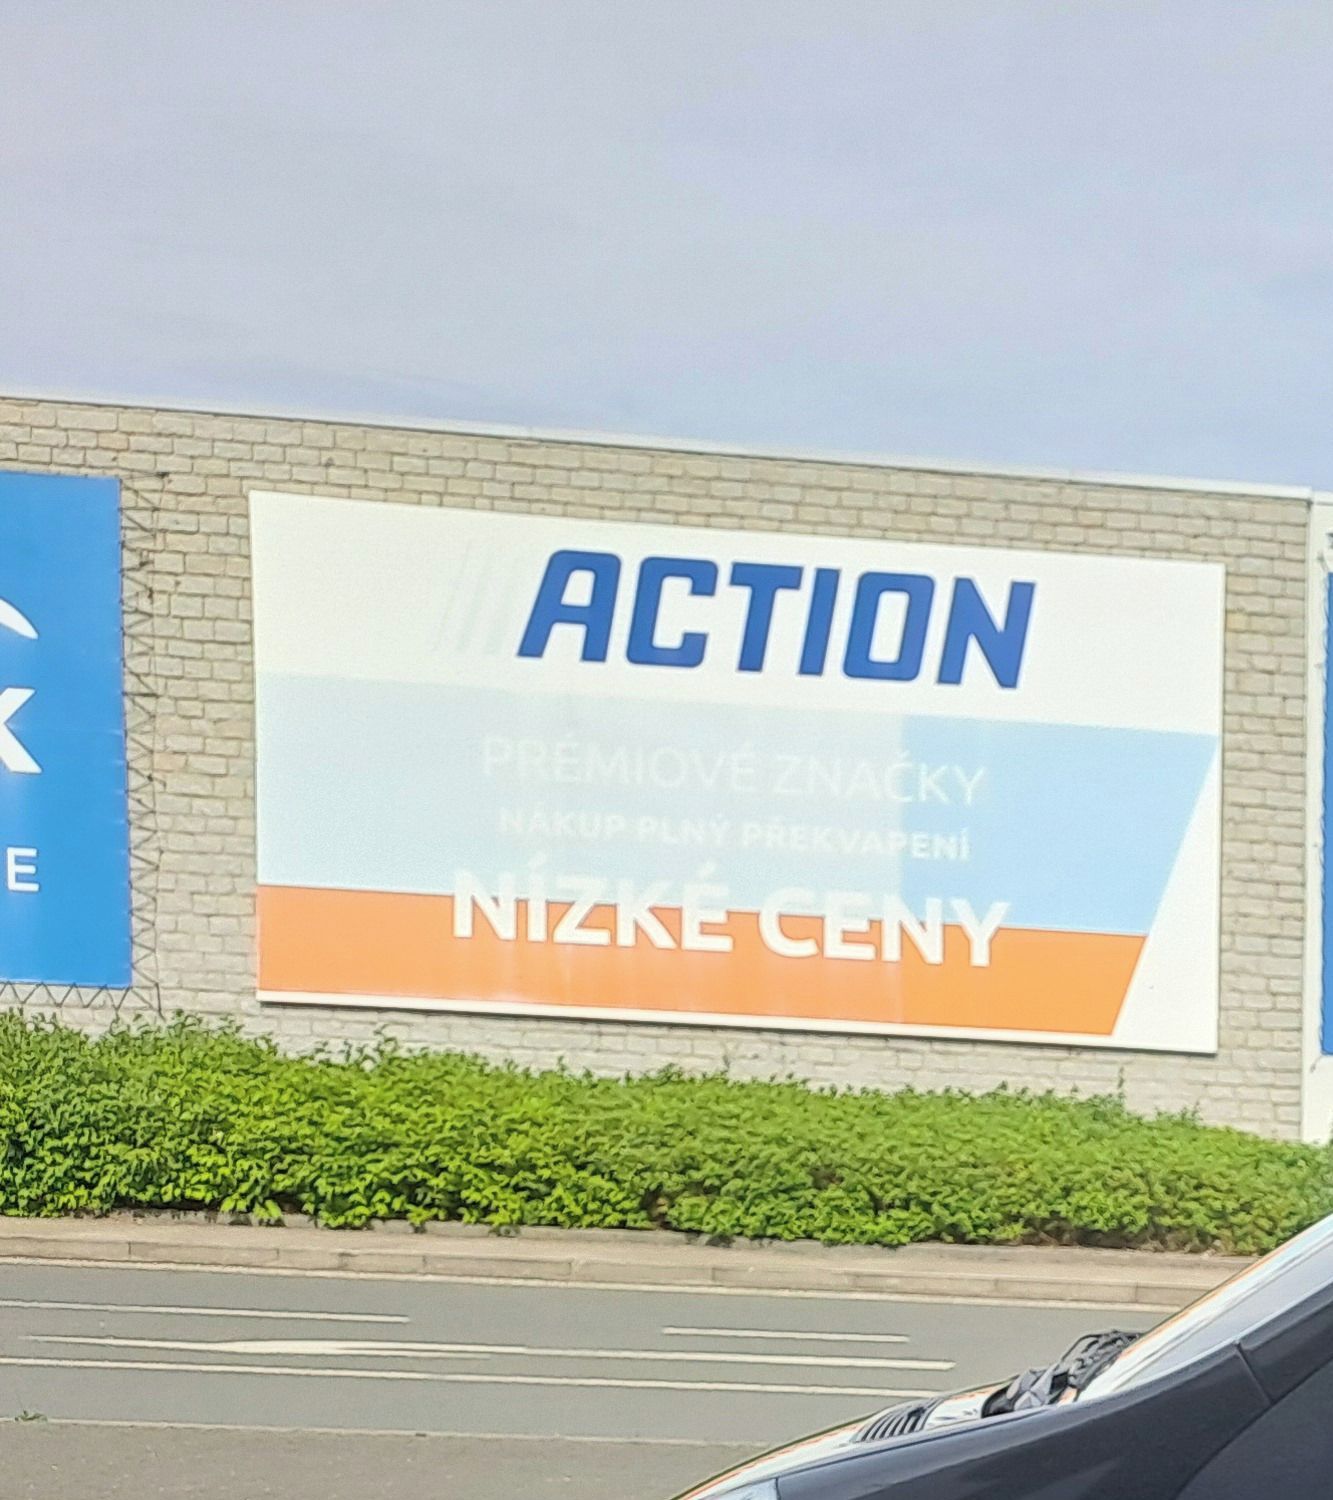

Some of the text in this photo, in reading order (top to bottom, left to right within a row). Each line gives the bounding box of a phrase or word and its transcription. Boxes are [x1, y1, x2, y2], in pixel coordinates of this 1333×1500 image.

[515, 549, 1036, 689] ACTION
[482, 733, 988, 808] PRÉMIOVÉ ZNAČKY
[499, 801, 972, 862] NÁKUP PLNÝ PŘEKVAPENÍ
[7, 847, 40, 893] E
[454, 856, 1010, 967] NÍZKÉ CENY
